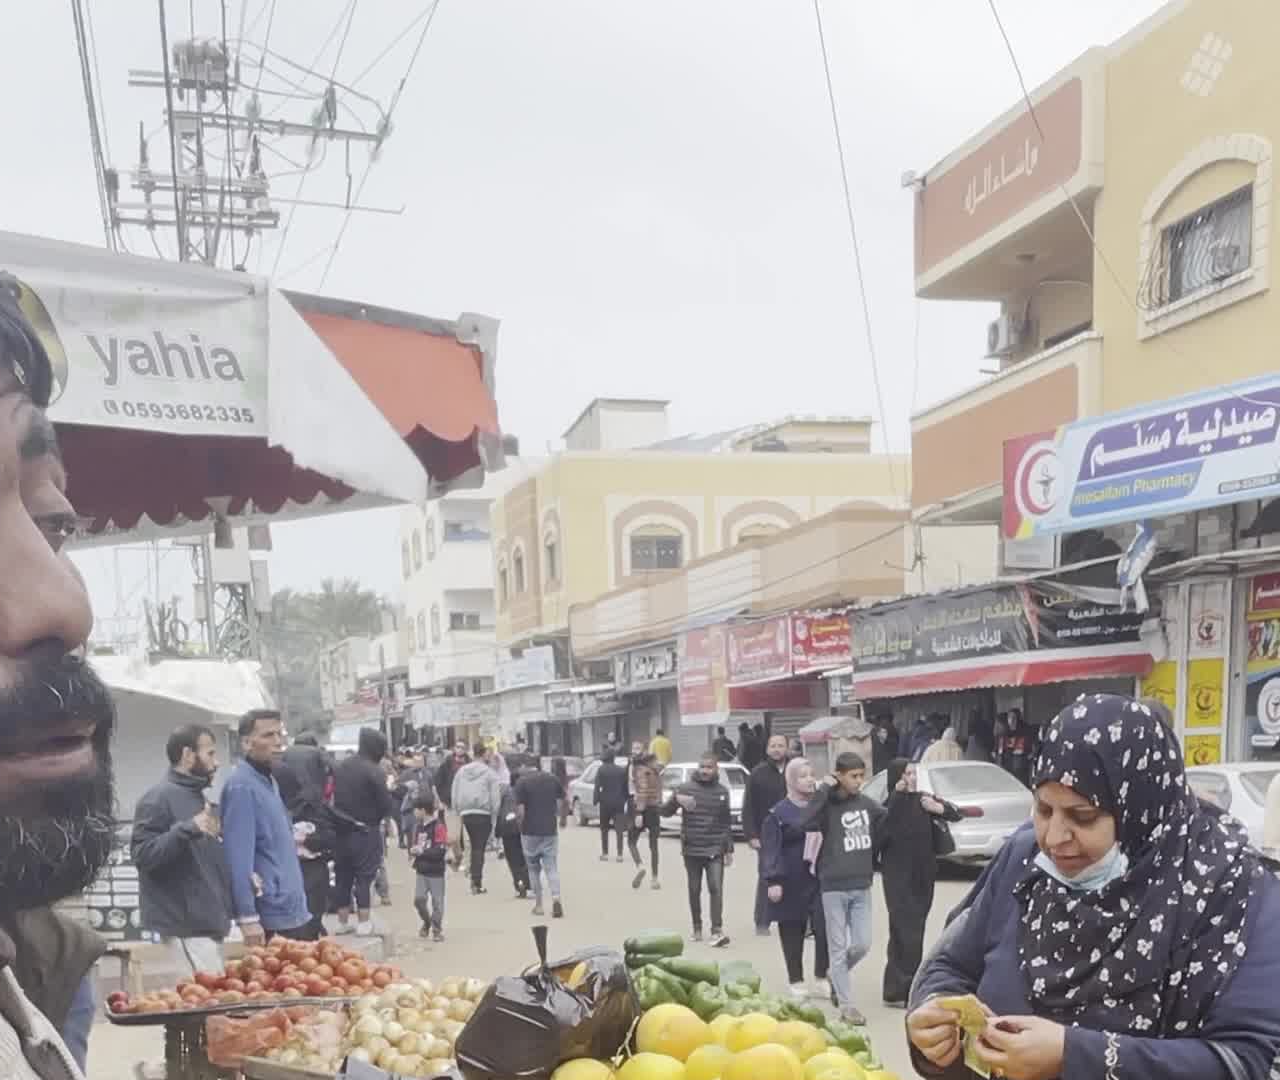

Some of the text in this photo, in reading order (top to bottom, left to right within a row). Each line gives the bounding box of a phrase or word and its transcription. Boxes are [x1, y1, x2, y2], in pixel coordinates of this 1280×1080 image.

[85, 329, 246, 387] yahia
[122, 400, 255, 425] 0593682335
[1175, 406, 1276, 455] صيدلية
[843, 834, 873, 854] DID
